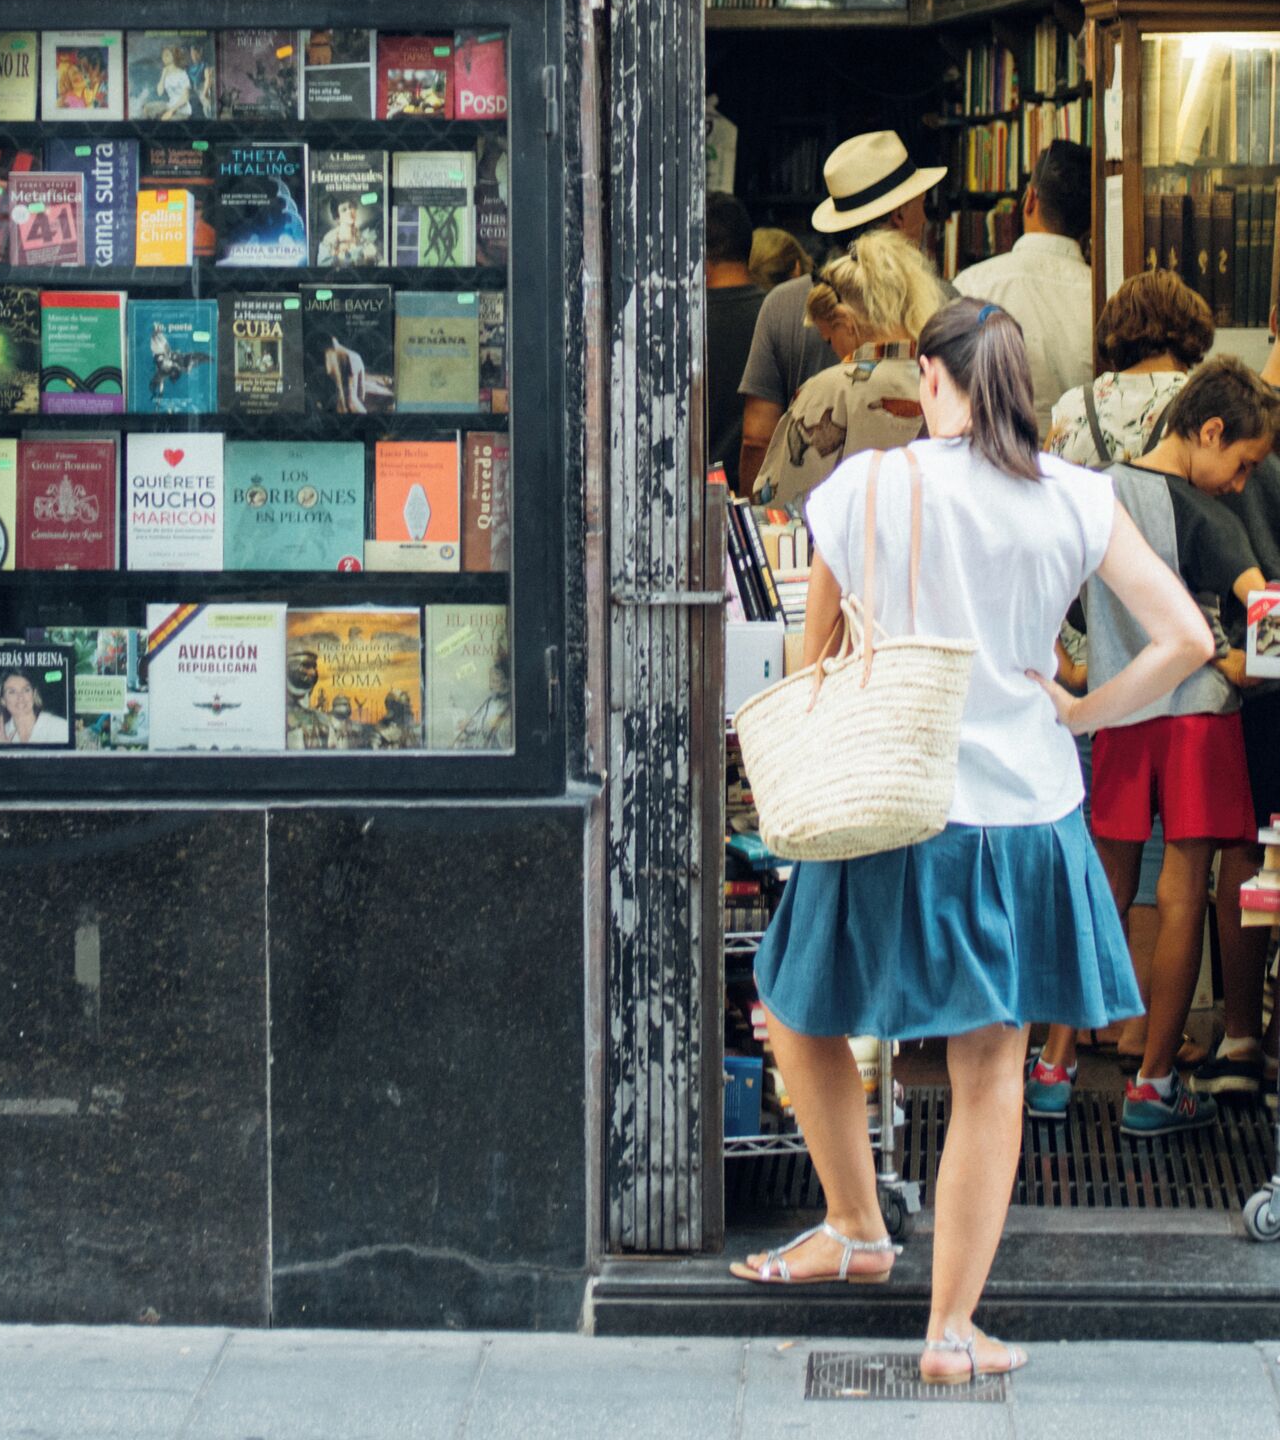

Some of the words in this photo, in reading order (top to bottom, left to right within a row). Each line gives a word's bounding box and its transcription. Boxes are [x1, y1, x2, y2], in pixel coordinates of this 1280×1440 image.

[232, 149, 287, 162] THETA
[92, 142, 114, 203] sutra
[220, 163, 297, 175] HEALING
[10, 188, 83, 203] Metafísica
[140, 211, 182, 222] Collins
[140, 230, 183, 242] Chino
[305, 299, 340, 311] JAIME
[344, 298, 384, 311] BAYLY
[232, 320, 284, 338] CUBA
[132, 473, 215, 489] QUIÉRETE
[281, 470, 309, 482] LOS
[477, 445, 493, 530] Quevedo
[132, 491, 216, 508] MUCHO
[255, 511, 275, 523] EN
[280, 511, 334, 523] PELOTA
[177, 641, 258, 660] AVIACIÓN
[37, 651, 64, 667] REINA
[177, 662, 258, 674] REPUBLICANA
[331, 674, 383, 688] ROMA
